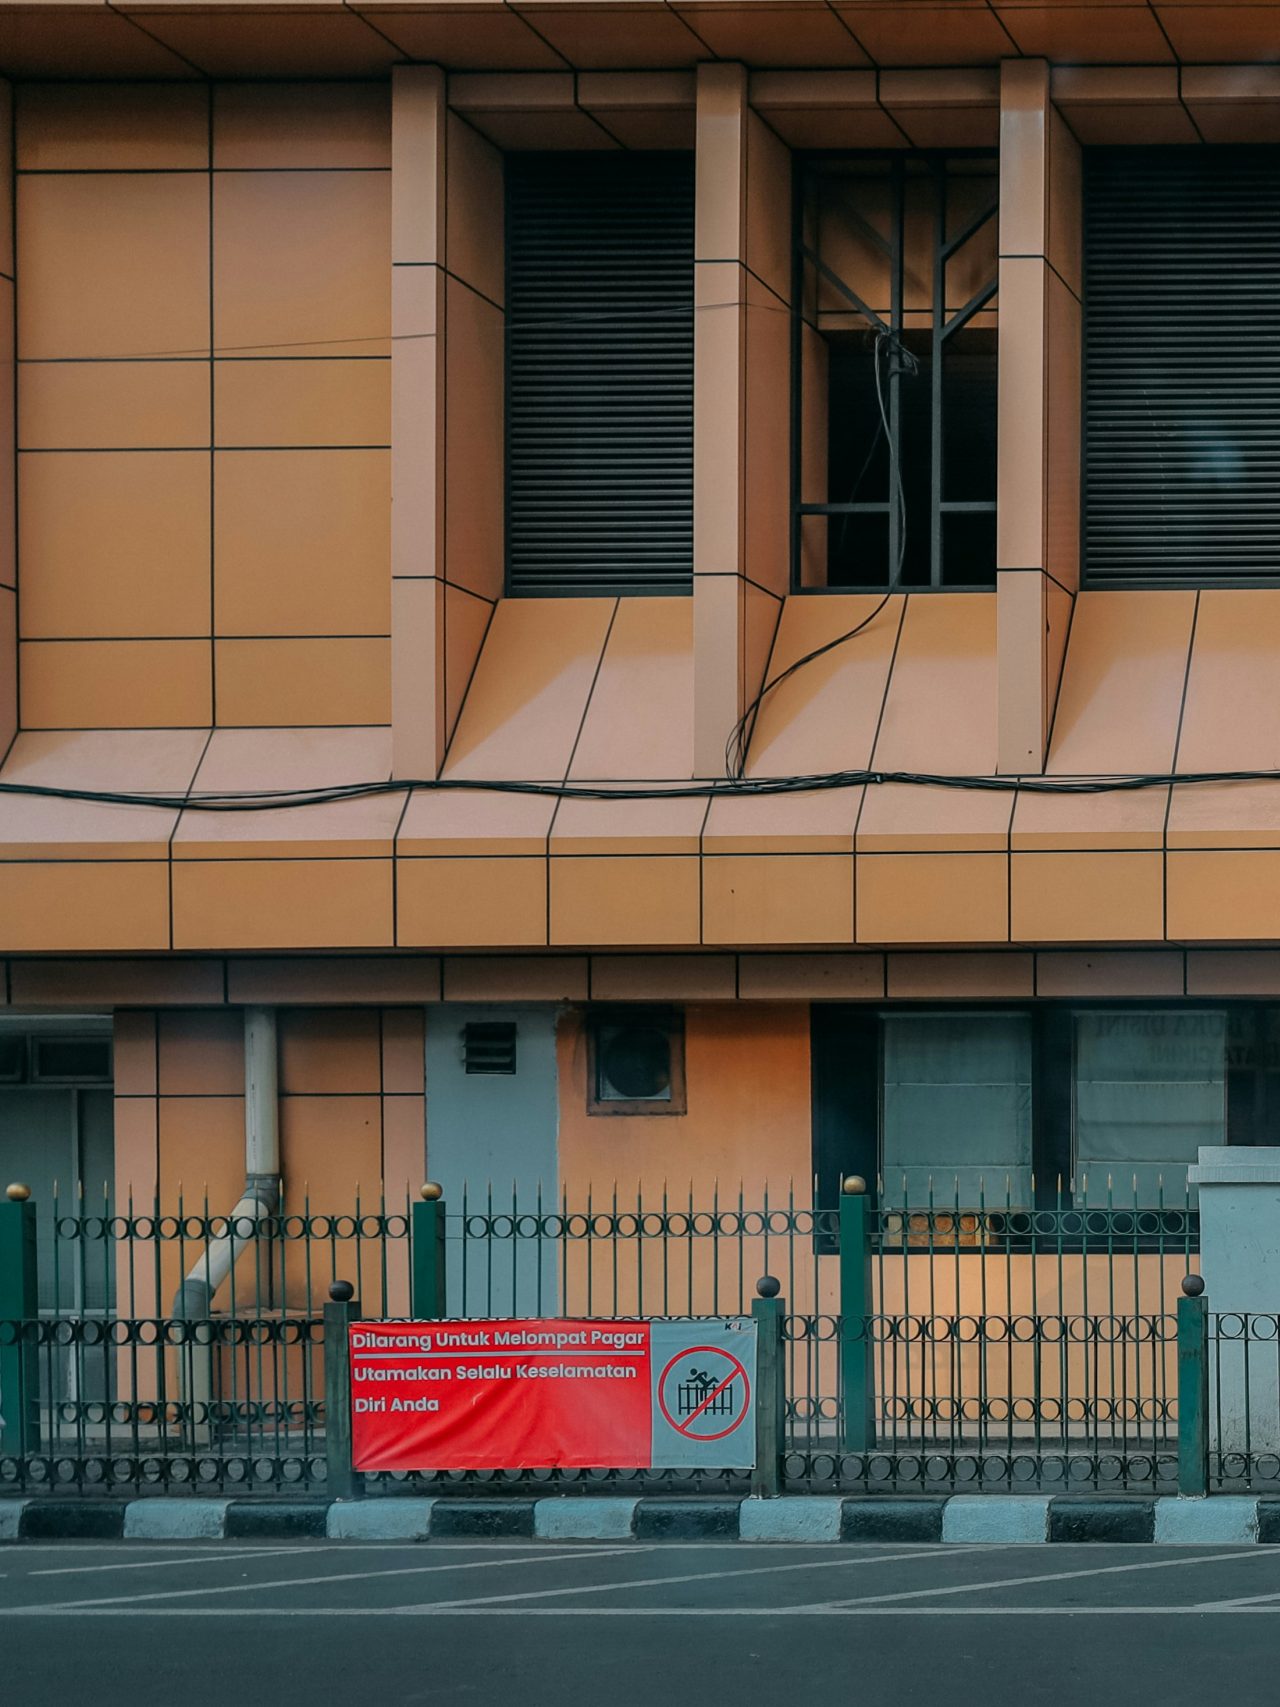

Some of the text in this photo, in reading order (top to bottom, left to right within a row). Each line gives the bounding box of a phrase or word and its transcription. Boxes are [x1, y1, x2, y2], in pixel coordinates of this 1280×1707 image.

[352, 1331, 644, 1351] Dilarang Untuk Melompat Pagar
[354, 1364, 636, 1381] Utamakan Selalu Keselamatan
[355, 1396, 439, 1413] Diri Anda
